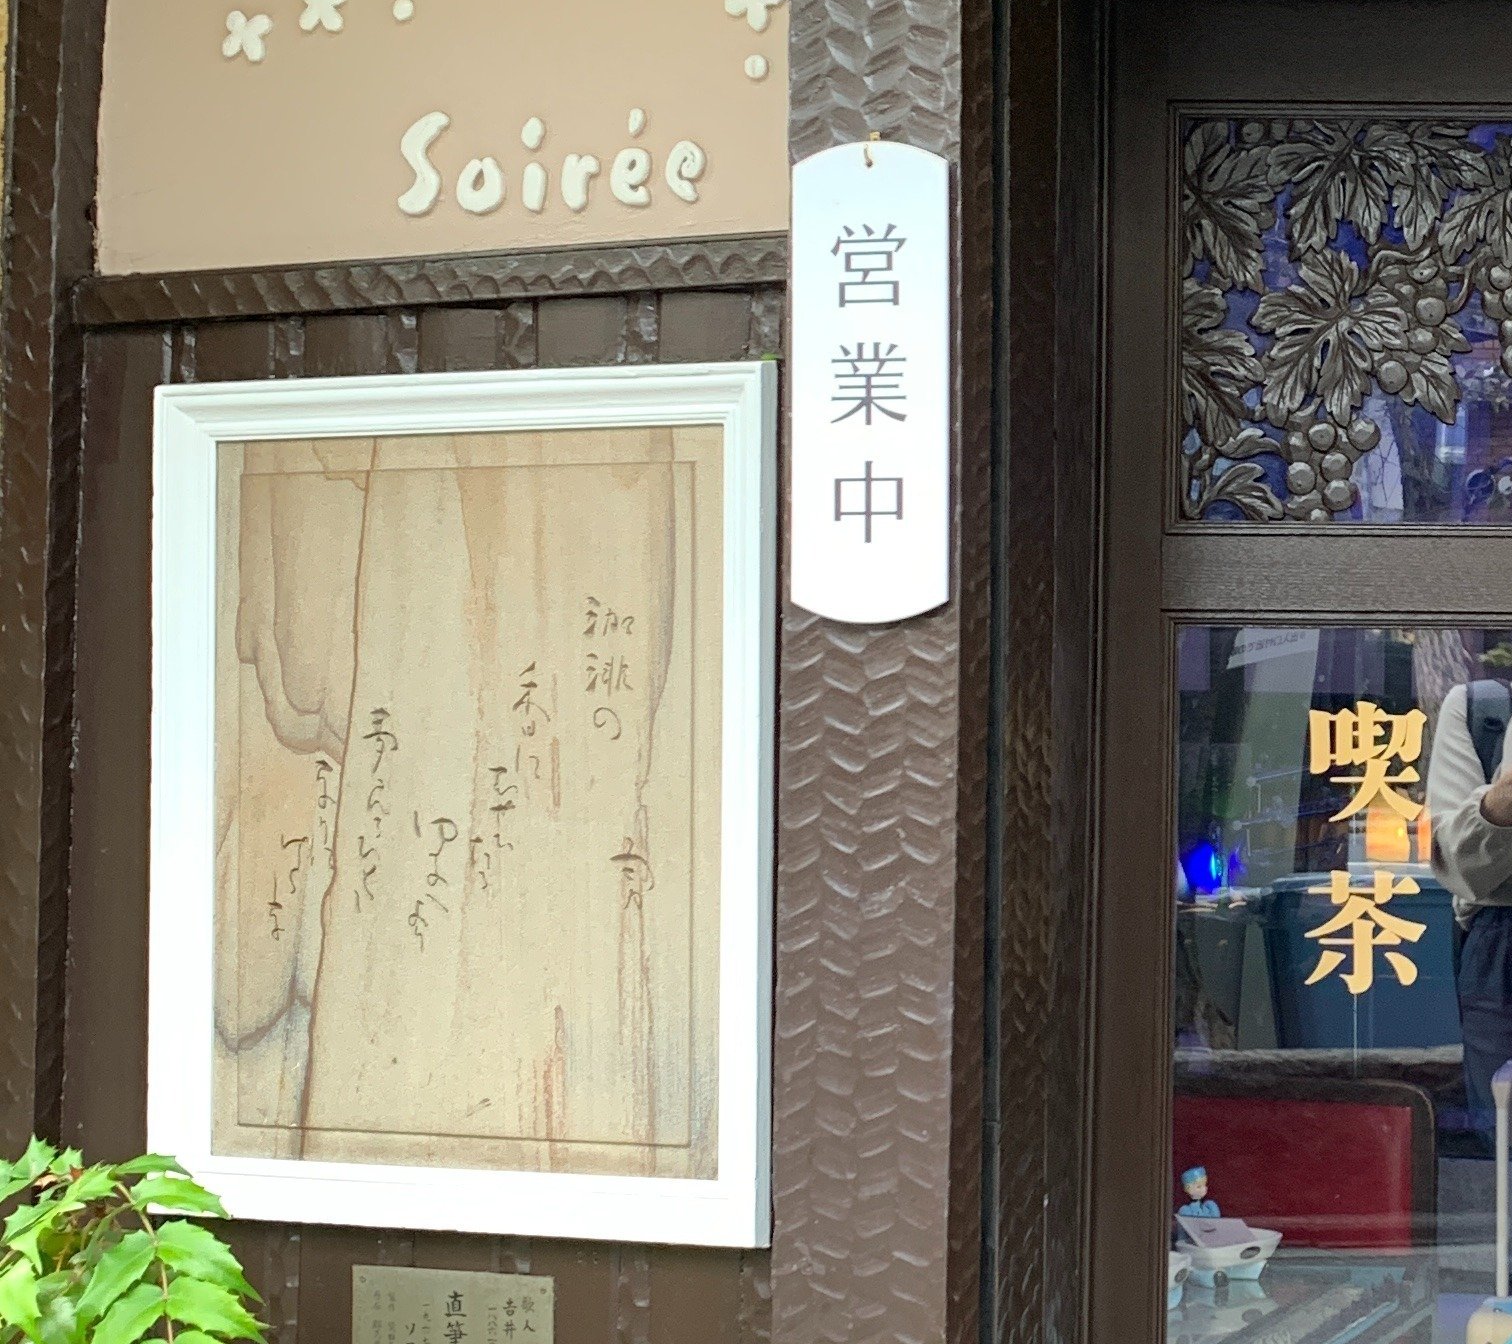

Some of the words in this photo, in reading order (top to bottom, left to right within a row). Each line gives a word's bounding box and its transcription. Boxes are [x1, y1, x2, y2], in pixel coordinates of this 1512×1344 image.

[396, 107, 707, 217] Soirée
[830, 222, 908, 545] 営業中
[1304, 700, 1429, 995] 喫茶
[520, 1296, 537, 1333] 歌人
